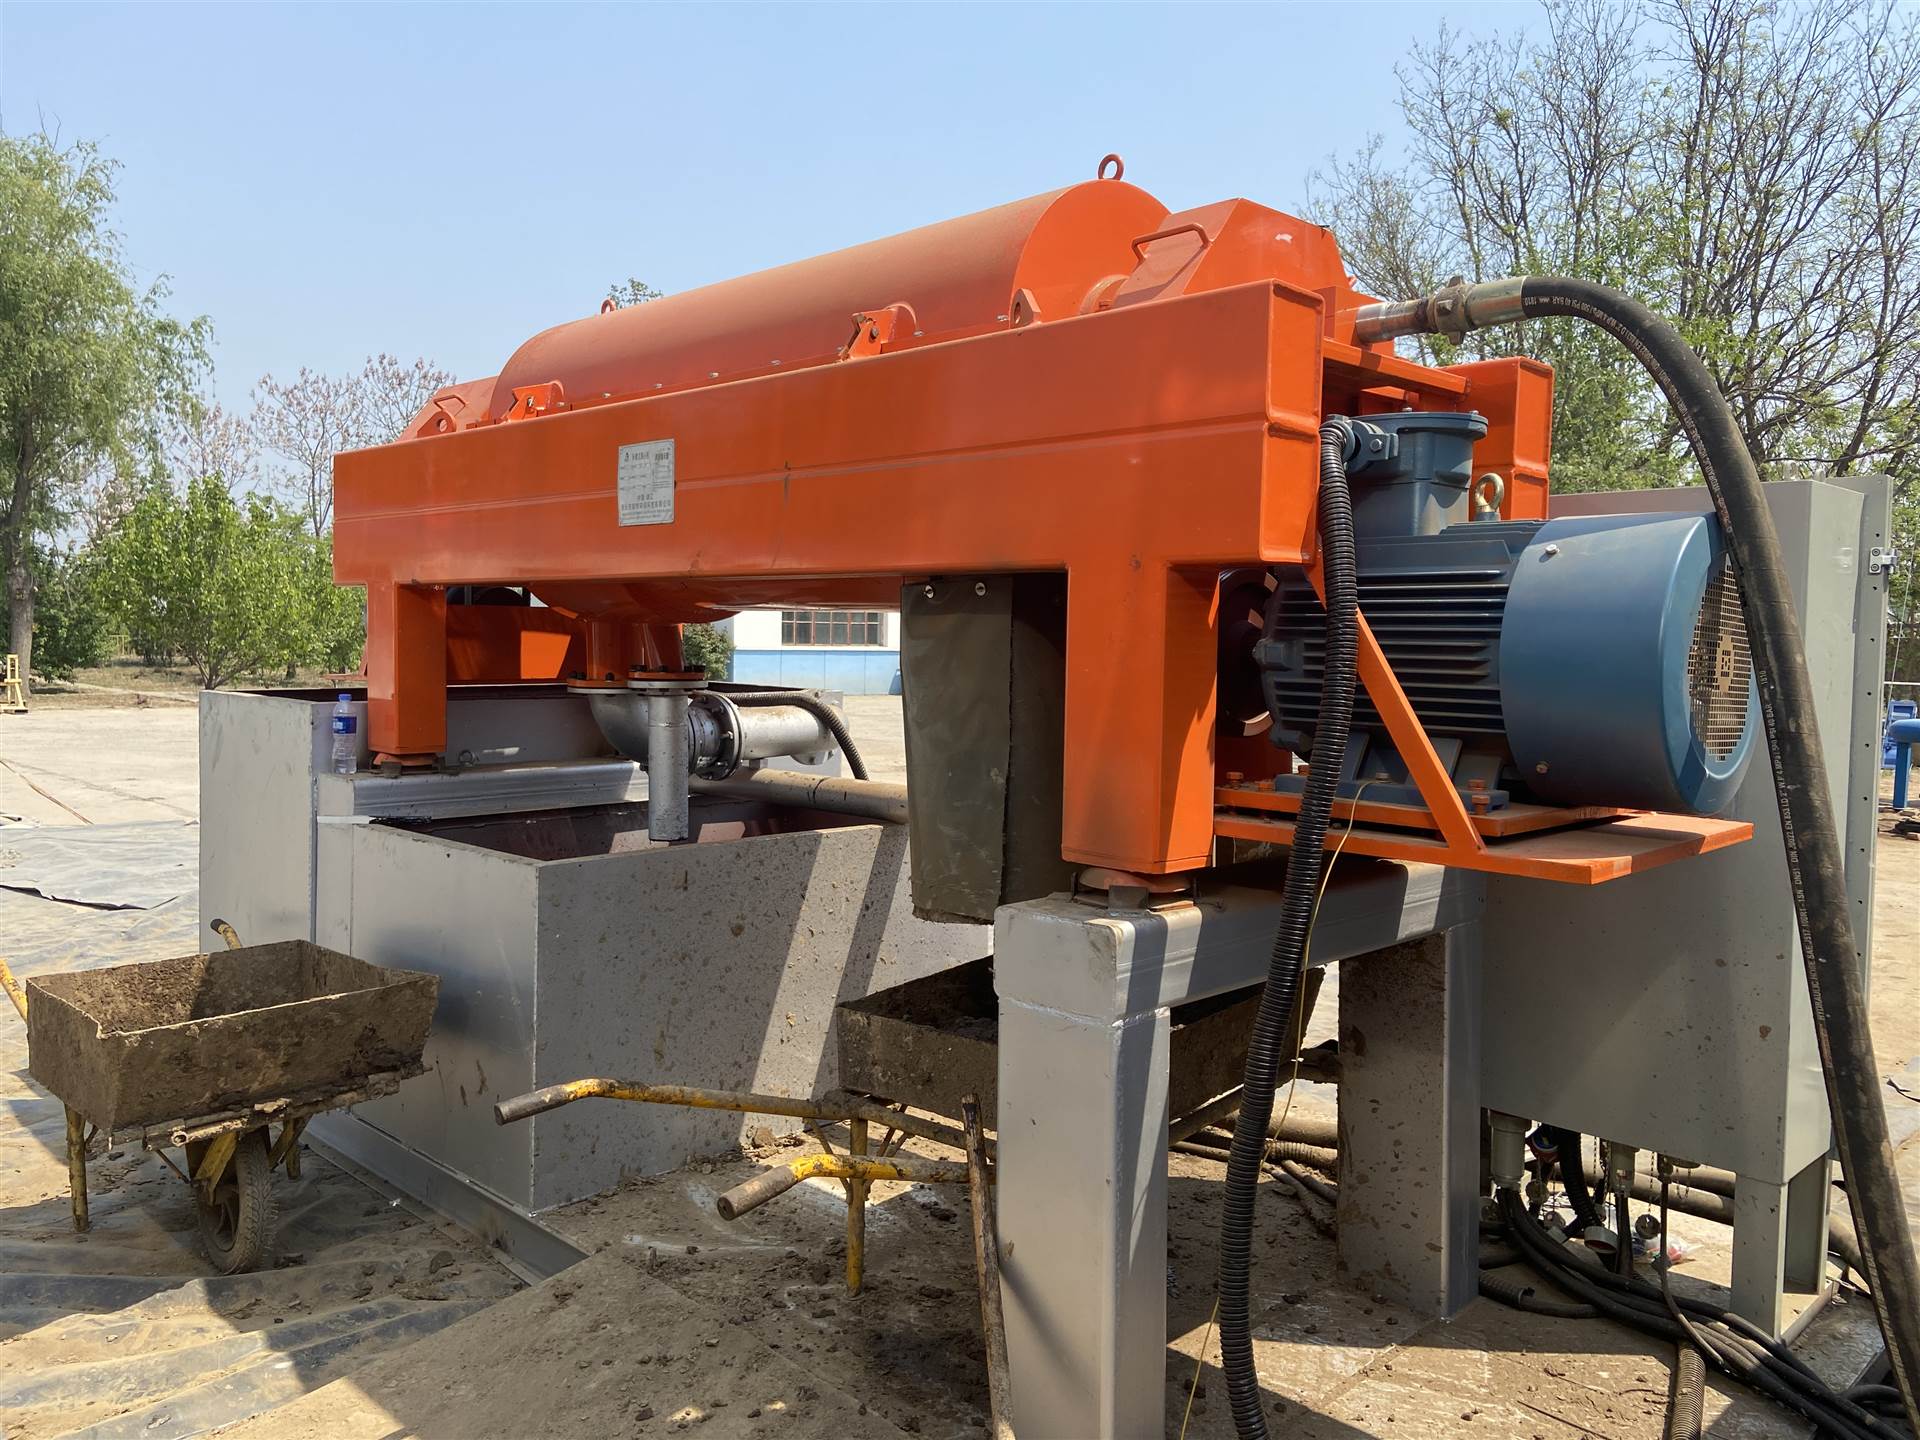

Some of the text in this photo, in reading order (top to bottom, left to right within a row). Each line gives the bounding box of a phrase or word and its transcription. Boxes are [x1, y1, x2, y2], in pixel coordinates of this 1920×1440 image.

[1766, 703, 1774, 718] BAR
[1784, 820, 1793, 830] EN
[1790, 850, 1799, 863] DIN
[1792, 868, 1802, 885] DN51
